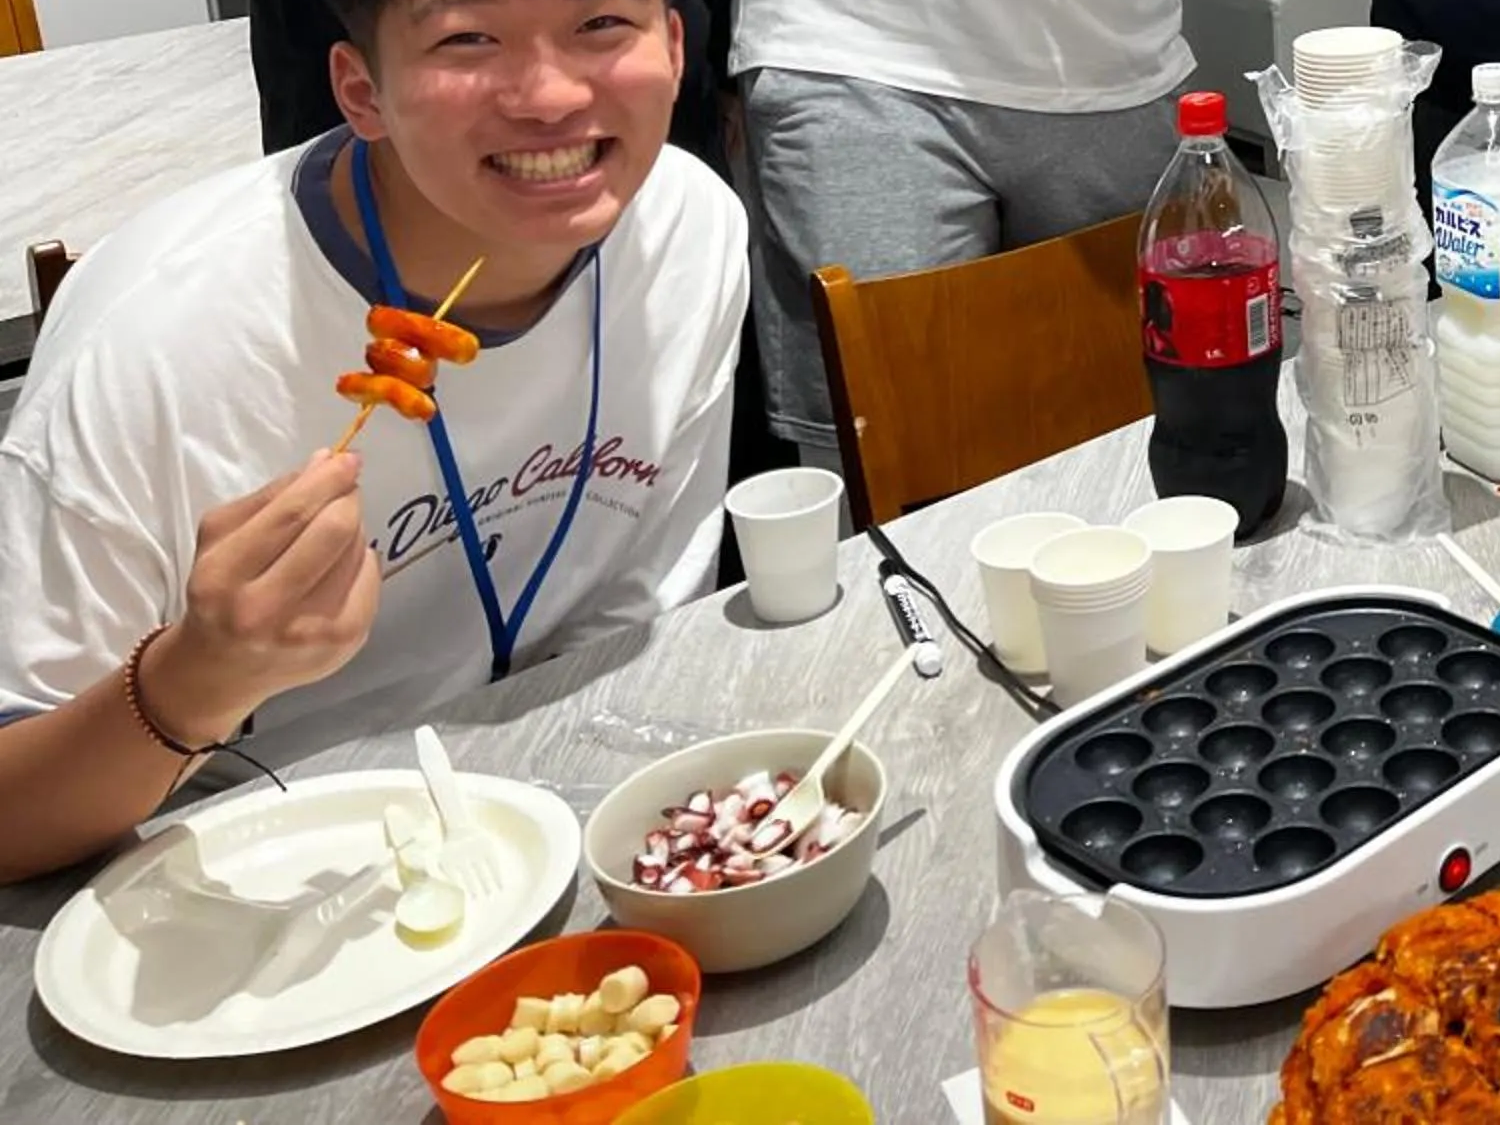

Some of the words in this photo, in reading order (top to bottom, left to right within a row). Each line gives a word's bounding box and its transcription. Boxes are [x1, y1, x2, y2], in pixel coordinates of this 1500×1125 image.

[1435, 206, 1481, 238] カルピス
[1435, 226, 1485, 257] Water
